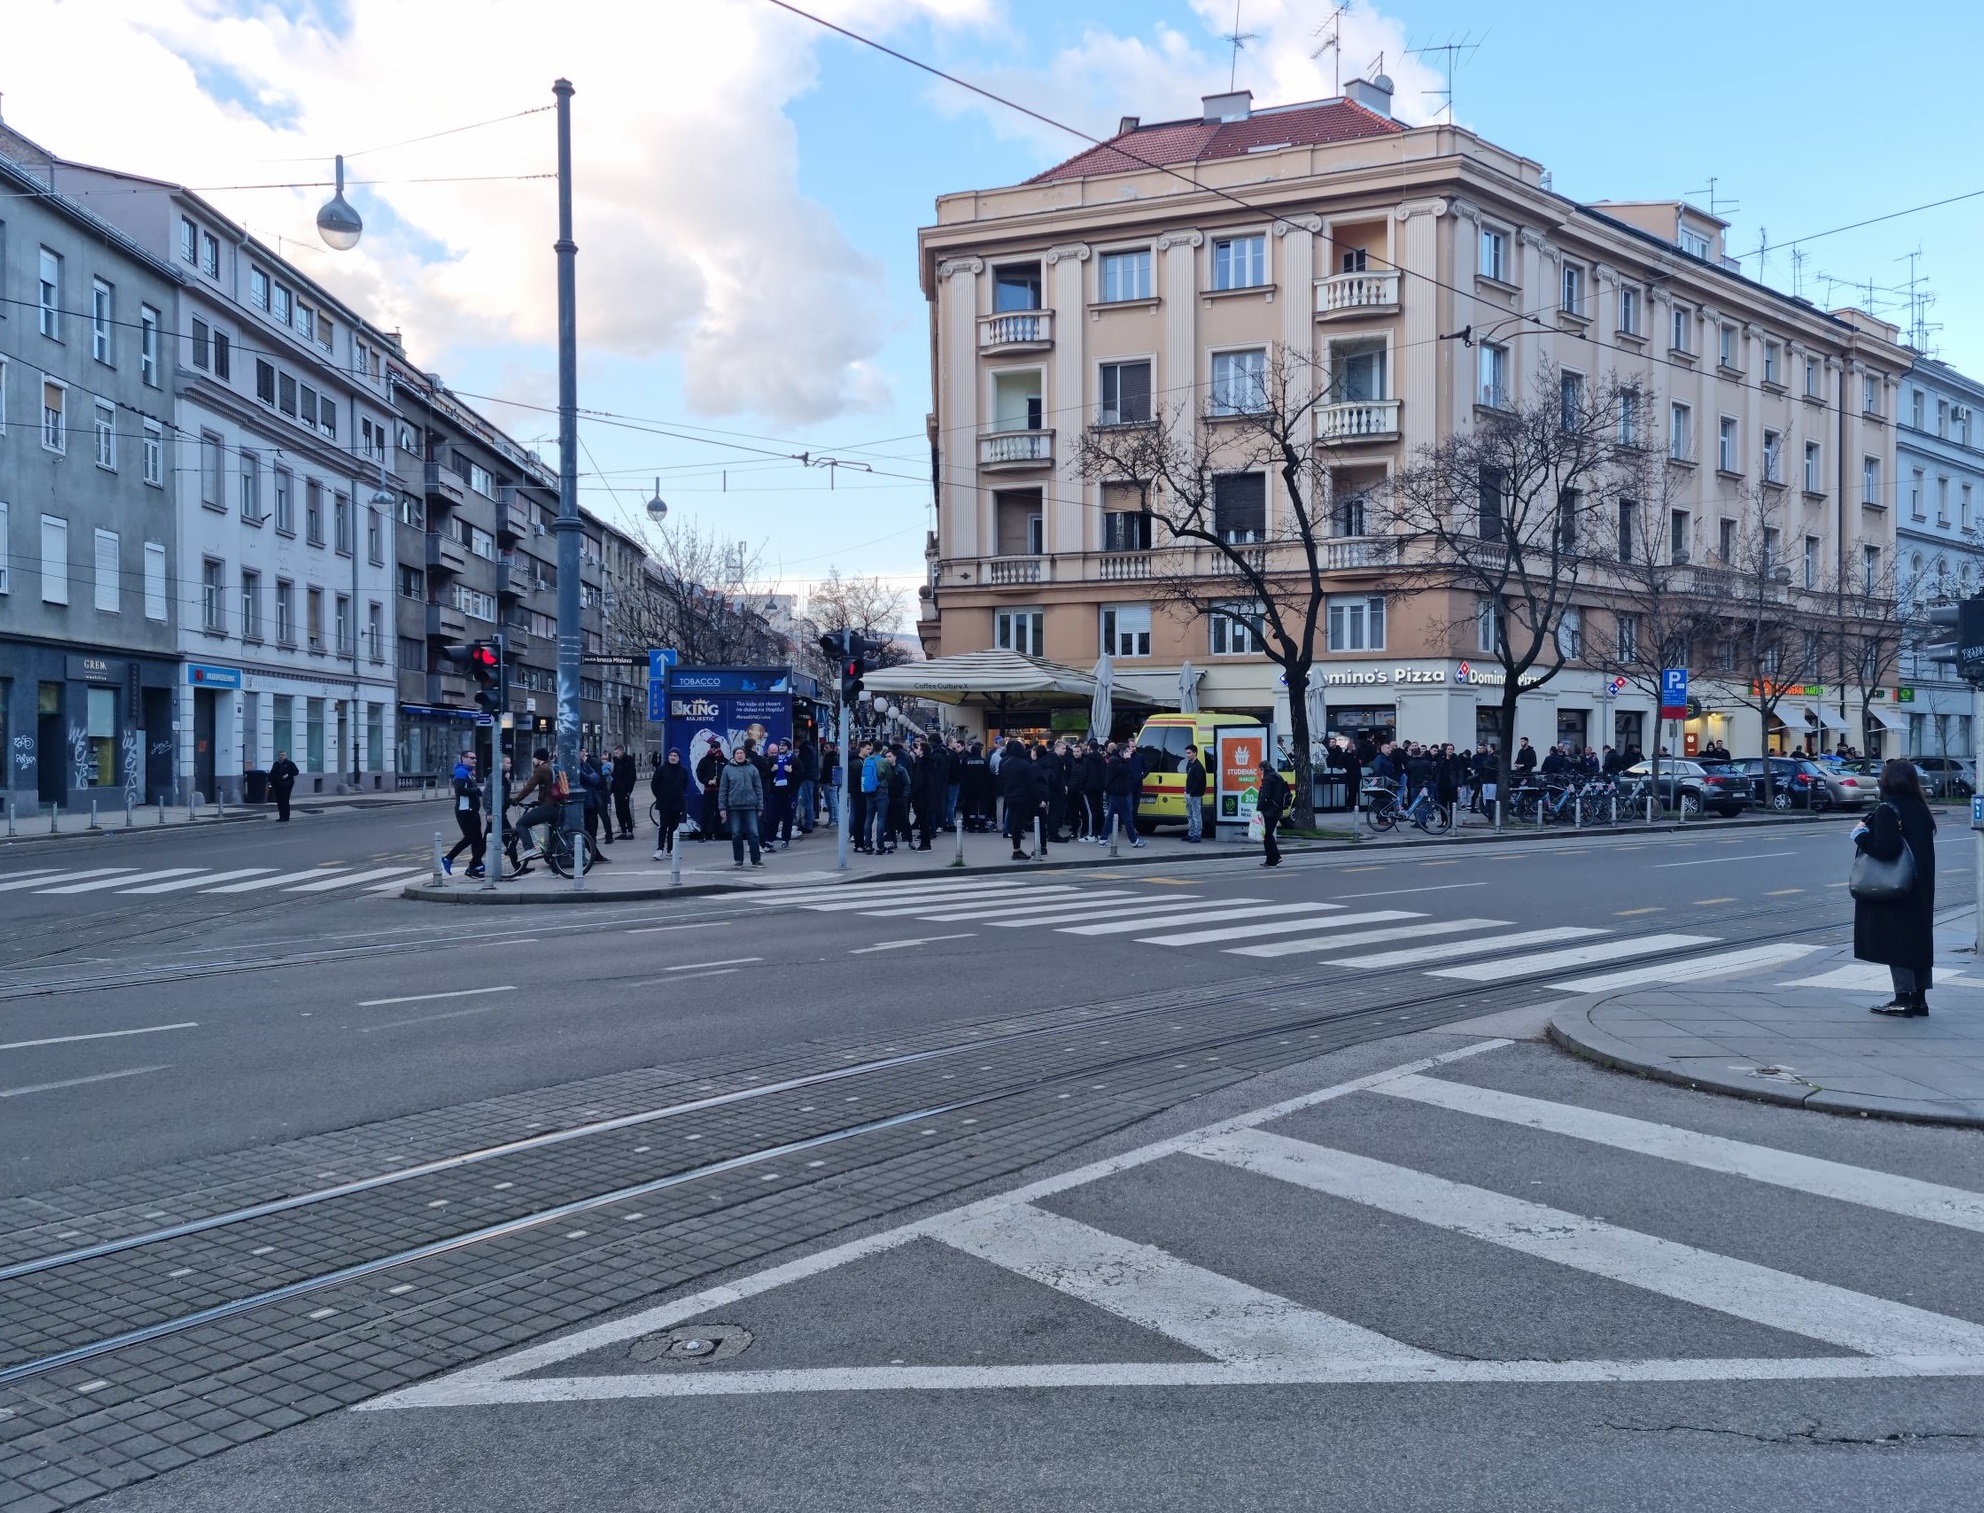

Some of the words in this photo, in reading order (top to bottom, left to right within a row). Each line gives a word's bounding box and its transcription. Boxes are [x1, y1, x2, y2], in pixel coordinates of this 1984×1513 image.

[1394, 667, 1445, 683] Pizza
[1668, 671, 1681, 689] P
[914, 682, 936, 690] Coffee
[682, 704, 719, 716] KING
